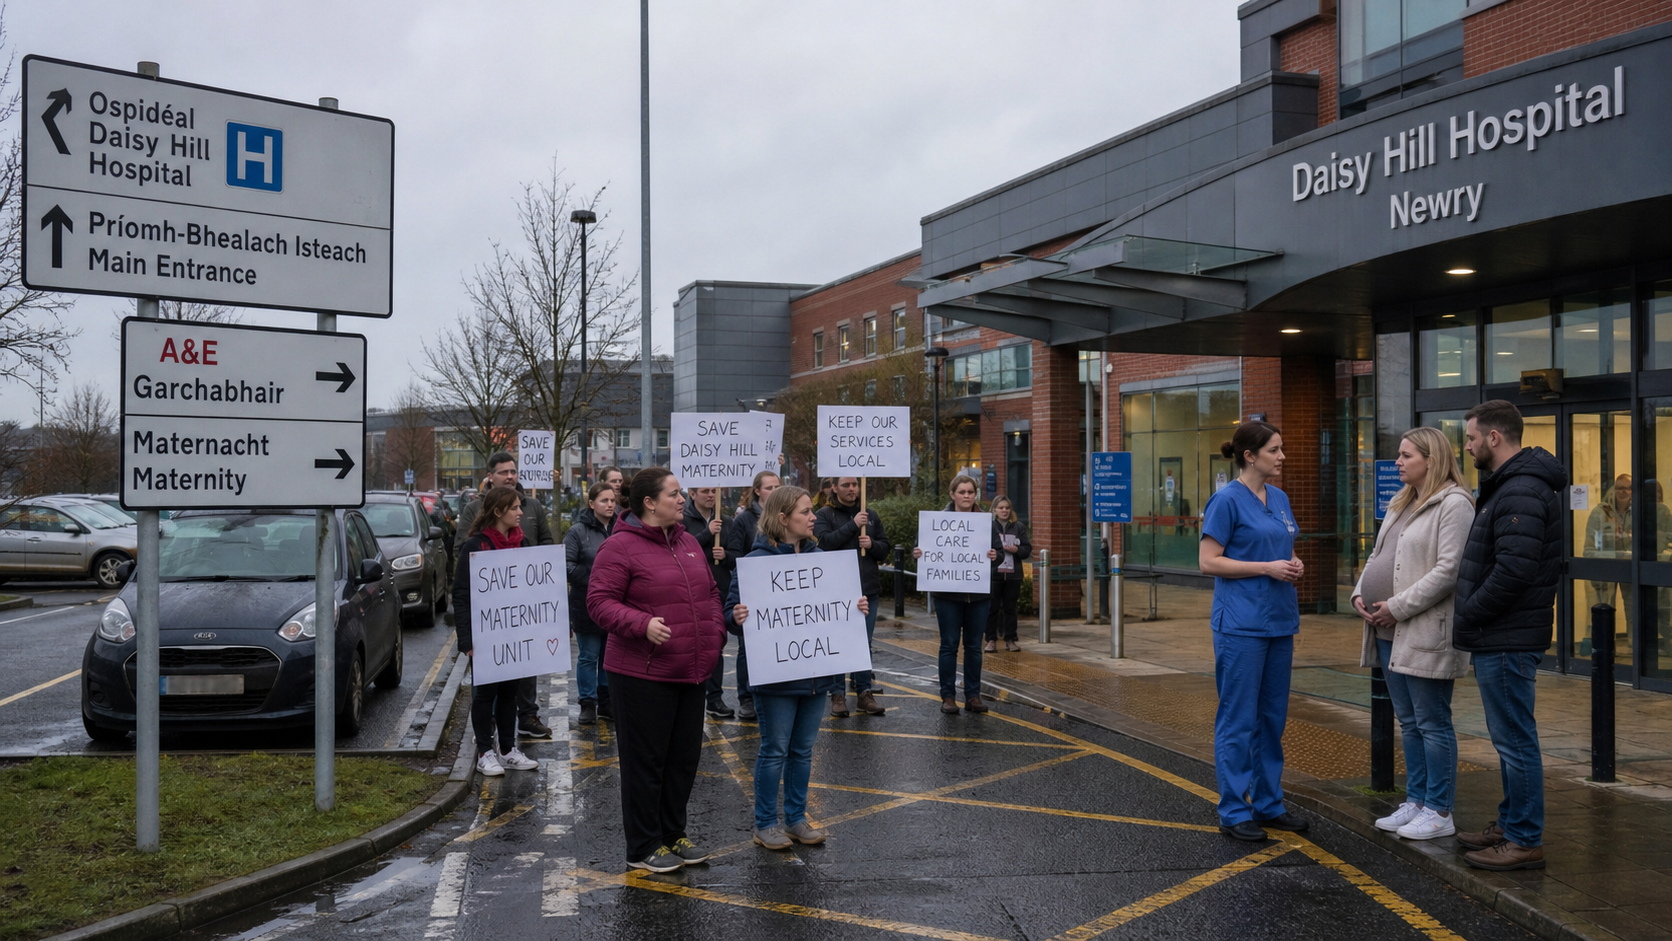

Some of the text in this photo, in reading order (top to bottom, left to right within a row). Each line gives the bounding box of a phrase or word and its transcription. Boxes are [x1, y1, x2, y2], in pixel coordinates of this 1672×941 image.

[89, 90, 195, 130] Ospidéal
[89, 120, 211, 162] Daisy Hill
[1292, 65, 1625, 202] Daisy Hill Hospital
[89, 150, 192, 188] Hospital
[237, 131, 273, 185] H
[1390, 182, 1485, 229] Newry
[89, 210, 367, 264] Príomh-Bhealach Isteach
[88, 247, 257, 286] Main Entrance
[159, 337, 218, 366] A&E
[133, 374, 285, 405] Garchabhair
[697, 420, 739, 437] SAVE
[829, 415, 898, 429] KEEP OUR
[133, 430, 270, 456] Maternacht
[521, 435, 550, 449] SAVE
[680, 443, 723, 458] DAISY
[729, 443, 758, 457] HILL
[830, 434, 894, 449] SERVICES
[523, 453, 546, 466] OUR
[681, 463, 756, 479] MATERNITY
[838, 454, 887, 468] LOCAL
[133, 466, 247, 497] Maternity
[932, 519, 975, 532] LOCAL
[935, 535, 969, 548] CARE
[924, 551, 984, 564] FOR LOCAL
[478, 561, 555, 593] SAVE OUR
[770, 566, 824, 593] KEEP
[926, 568, 981, 582] FAMILIES
[480, 600, 559, 633] MATERNITY
[756, 599, 852, 631] MATERNITY
[493, 638, 534, 666] UNIT
[775, 636, 840, 663] LOCAL
